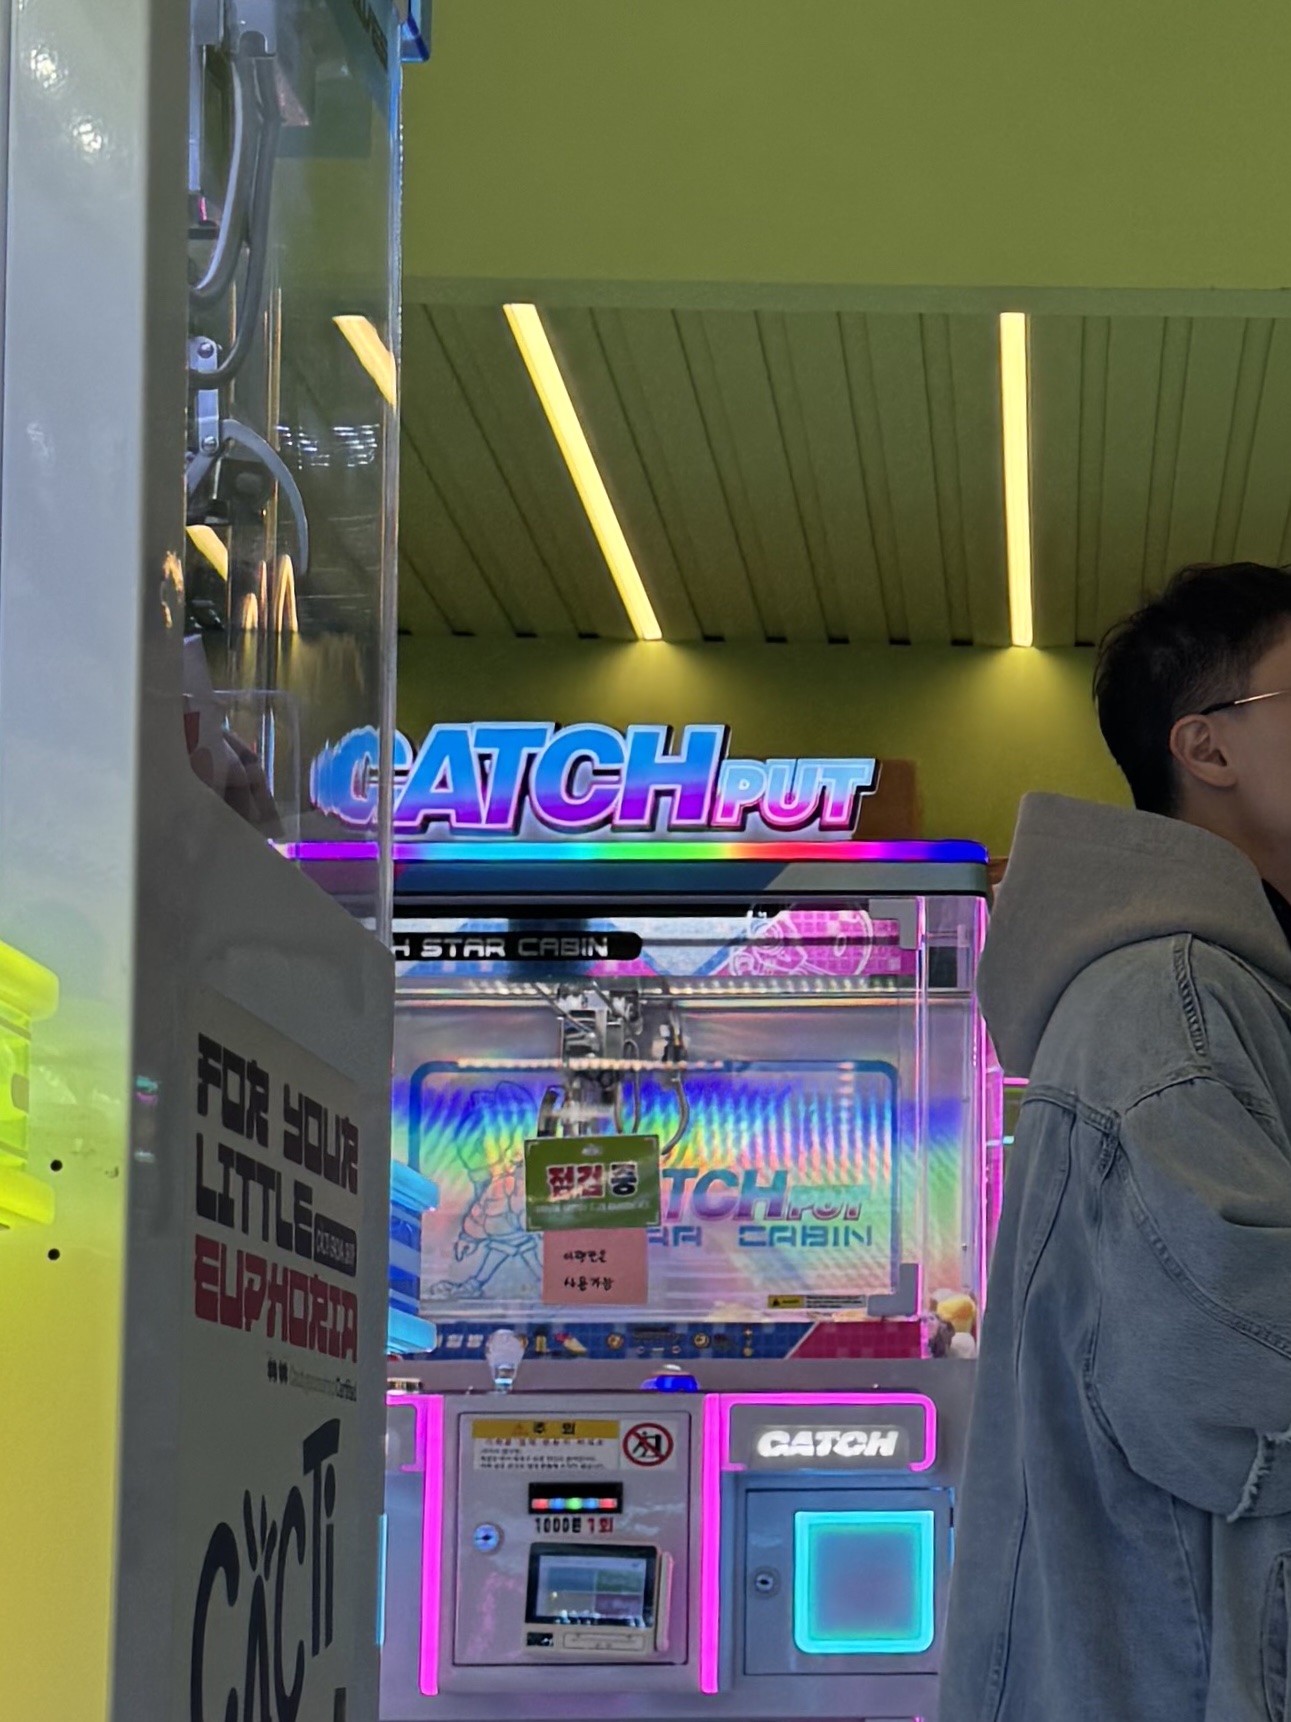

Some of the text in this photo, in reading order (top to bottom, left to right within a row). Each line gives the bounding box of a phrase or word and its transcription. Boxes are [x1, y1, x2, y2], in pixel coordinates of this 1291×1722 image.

[709, 757, 880, 830] PUT
[421, 937, 506, 958] STAR
[518, 937, 608, 957] CABIN
[197, 1031, 359, 1194] FOR YOUR
[196, 1132, 313, 1260] LITTLE
[661, 1168, 788, 1223] TCH
[646, 1225, 873, 1248] AR CABIN
[194, 1233, 358, 1363] EUPHORIA
[757, 1429, 899, 1457] CATCH
[535, 1518, 581, 1533] 1000원
